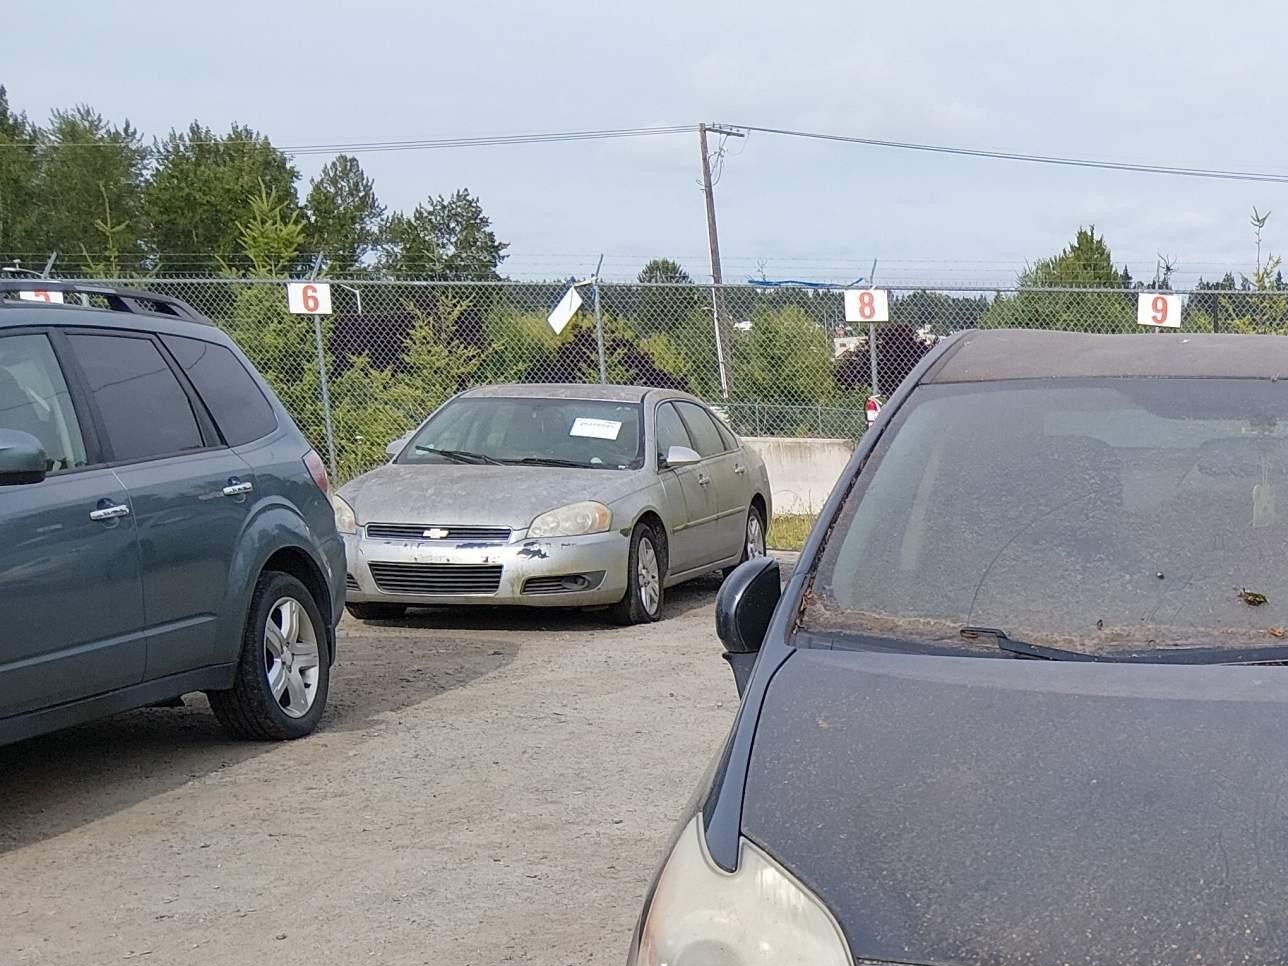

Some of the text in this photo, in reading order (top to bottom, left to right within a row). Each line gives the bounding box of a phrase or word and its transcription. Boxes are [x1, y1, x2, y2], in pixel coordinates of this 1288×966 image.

[302, 285, 319, 313] 6
[859, 292, 875, 320] 8
[1152, 296, 1168, 324] 9
